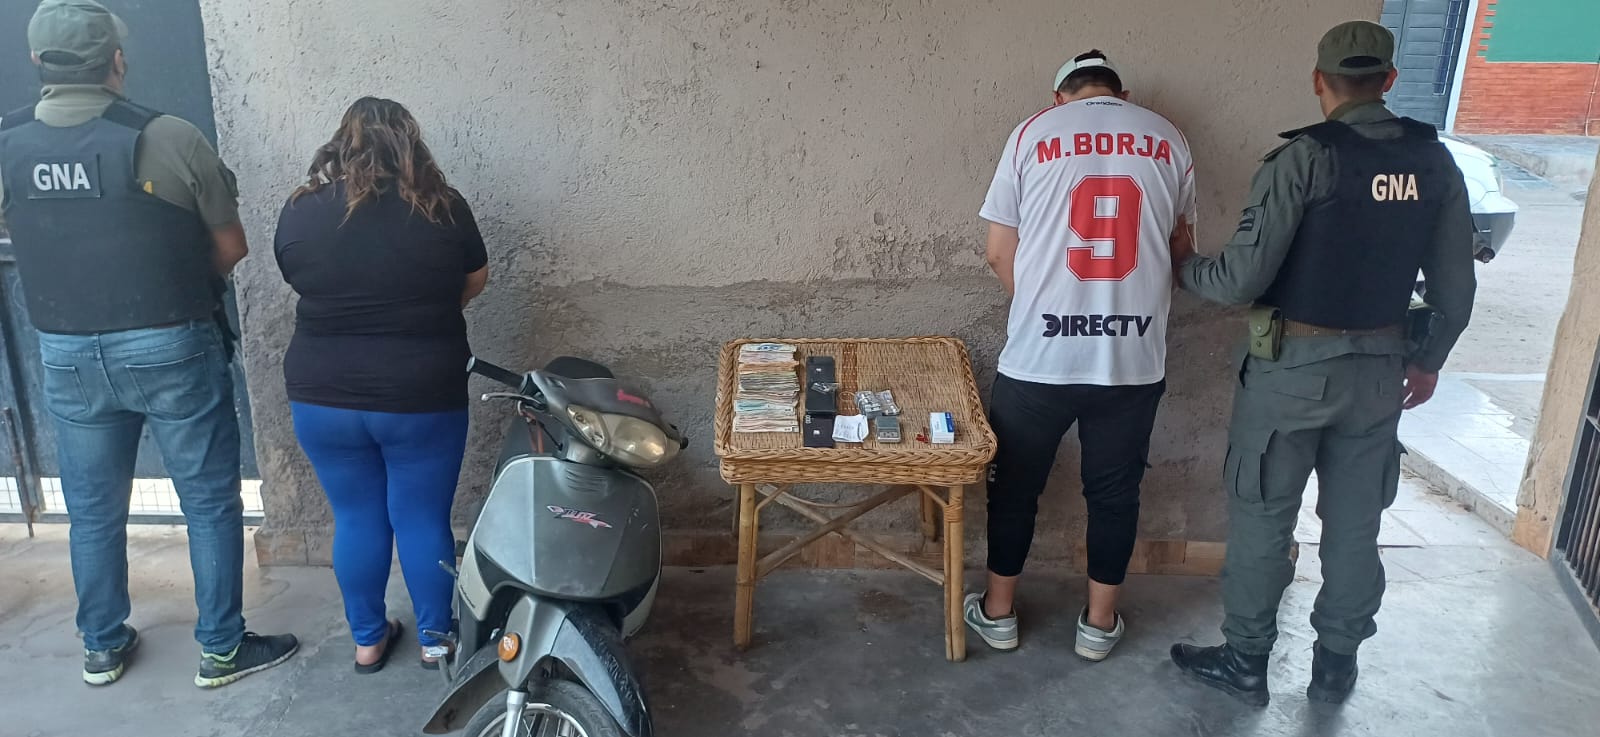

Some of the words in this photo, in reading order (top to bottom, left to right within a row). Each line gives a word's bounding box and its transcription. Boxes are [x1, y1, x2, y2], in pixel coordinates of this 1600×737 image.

[1037, 132, 1171, 165] M.BORJA
[33, 162, 91, 191] GNA
[1371, 173, 1419, 201] GNA
[1066, 174, 1143, 282] 9
[1041, 313, 1153, 337] DIRECTV
